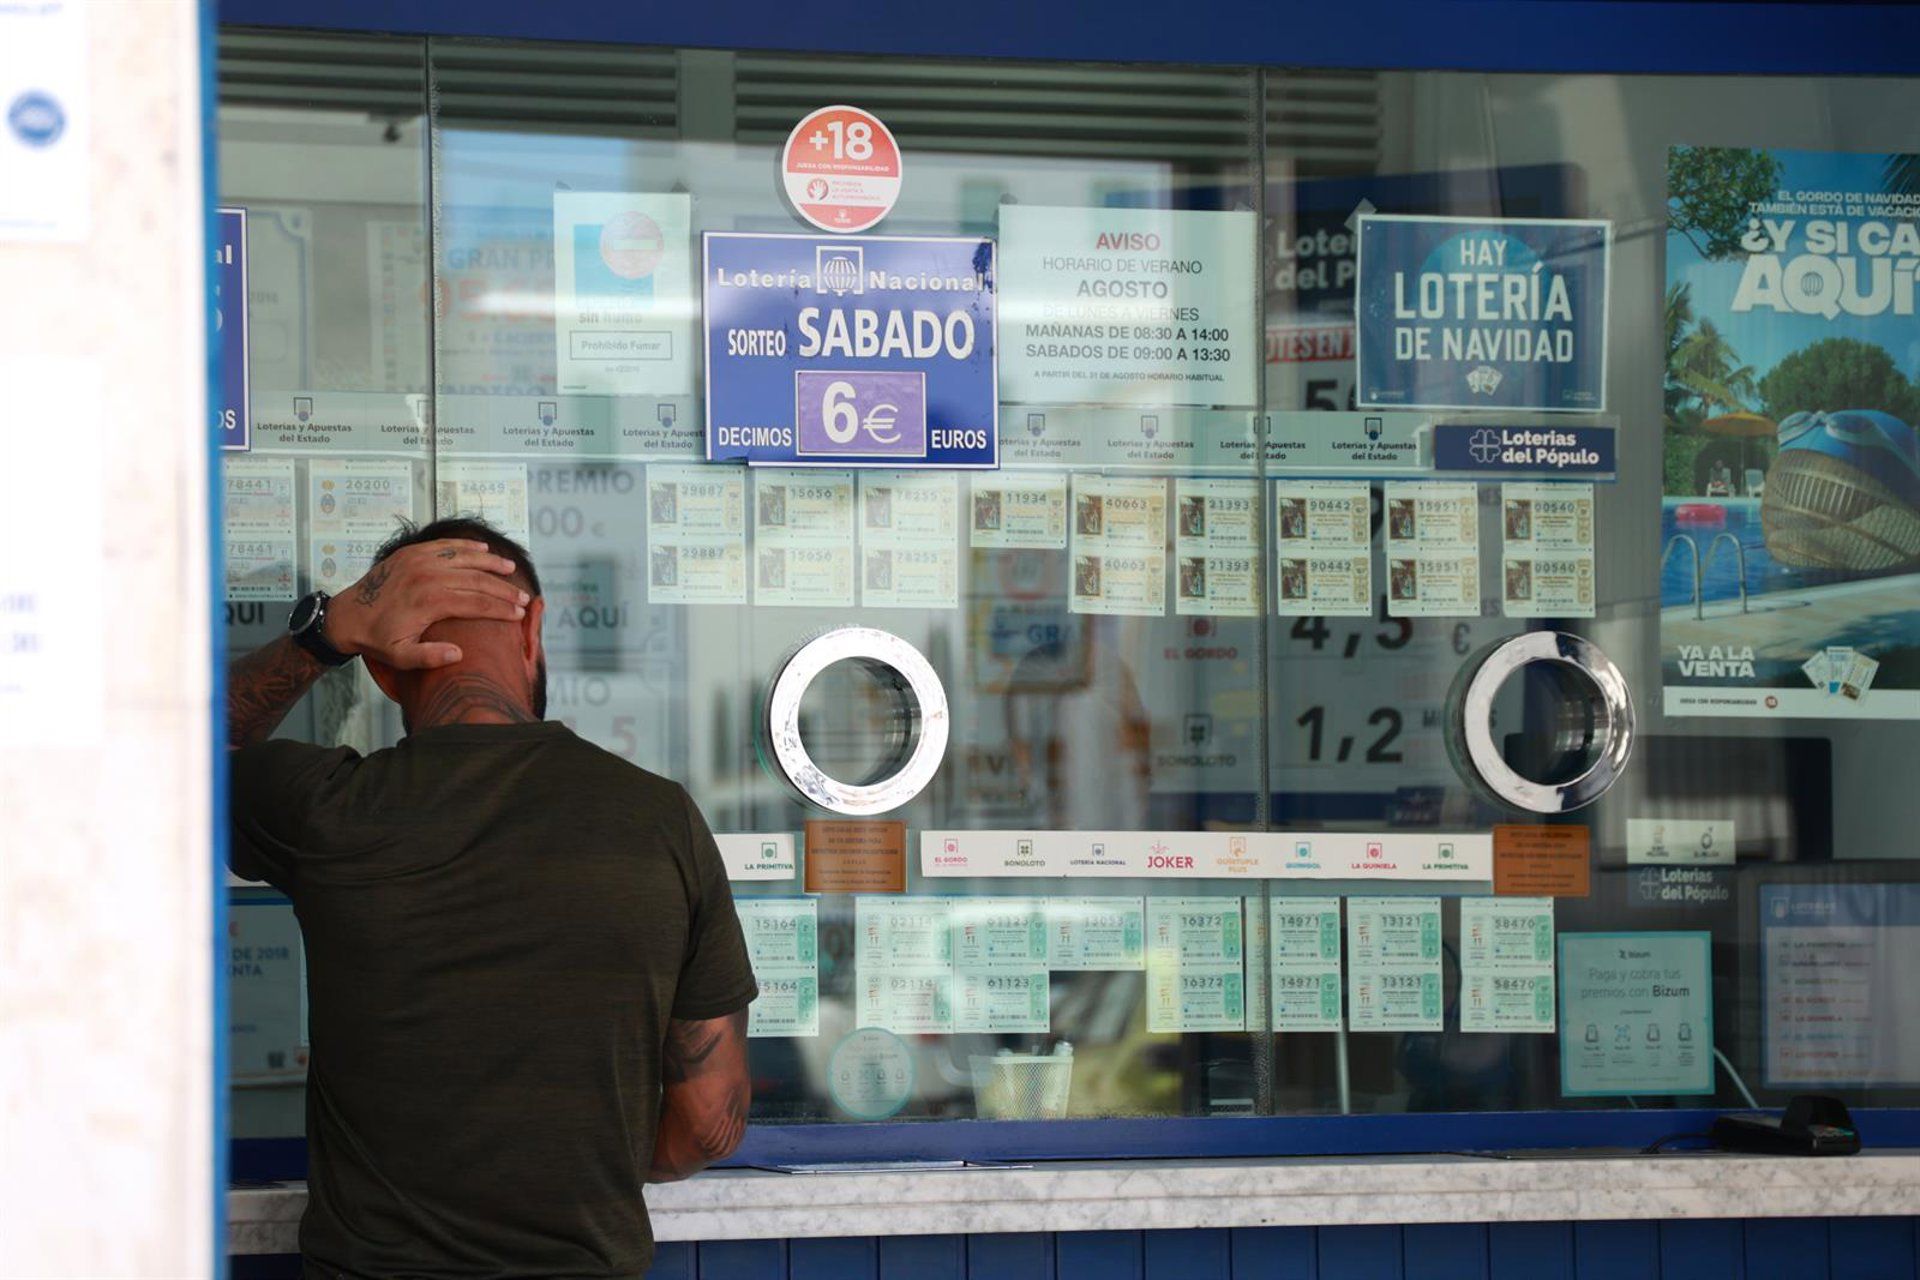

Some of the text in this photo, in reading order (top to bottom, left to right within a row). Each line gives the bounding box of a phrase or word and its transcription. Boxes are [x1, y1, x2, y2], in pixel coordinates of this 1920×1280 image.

[809, 121, 873, 160] +18
[1778, 191, 1792, 201] EL
[1796, 191, 1842, 203] GORDO
[1845, 192, 1863, 203] DE
[1749, 202, 1808, 215] TAMBIÉN
[1809, 202, 1844, 216] ESTÁ
[1847, 205, 1864, 217] DE
[1096, 232, 1160, 251] AVISO
[1741, 217, 1796, 252] ¿Y
[1805, 220, 1848, 255] SI
[1461, 239, 1508, 266] HAY
[1043, 257, 1202, 274] HORARIO DE VERANO
[718, 267, 984, 291] Lotería Nacional
[1077, 280, 1168, 299] AGOSTO
[1395, 260, 1573, 321] LOTERÍA
[1138, 307, 1200, 321] VIERNES
[728, 307, 975, 360] SORTEO SABADO
[1026, 322, 1229, 342] MAÑANAS DE 08:30 A 14:00
[1395, 327, 1573, 363] DE NAVIDAD
[1026, 345, 1231, 362] SABADOS DE 09:00 A 13:30
[1042, 371, 1071, 379] PARTIR
[1112, 373, 1146, 381] AGOSTO
[1147, 374, 1184, 382] HORARIO
[1185, 374, 1225, 382] HABITUAL
[307, 423, 352, 434] Apuestas
[552, 427, 595, 438] Apuestas
[719, 426, 792, 447] DECIMOS
[279, 433, 330, 445] del Estado
[403, 436, 418, 446] del
[524, 438, 575, 449] del Estado
[644, 440, 693, 450] del Estado
[932, 429, 987, 449] EUROS
[1040, 438, 1081, 449] Apuestas
[1153, 440, 1194, 450] Apuestas
[1376, 442, 1417, 452] Apuestas
[1352, 452, 1398, 461] del Estado
[1502, 448, 1600, 467] del Pópulo
[1678, 646, 1755, 660] YA A LA
[1678, 661, 1755, 677] VENTA
[1297, 706, 1404, 763] 1,2
[1148, 856, 1194, 869] JOKER
[1630, 968, 1661, 980] cobra
[1580, 986, 1626, 1001] premios
[1652, 984, 1690, 998] Bizum
